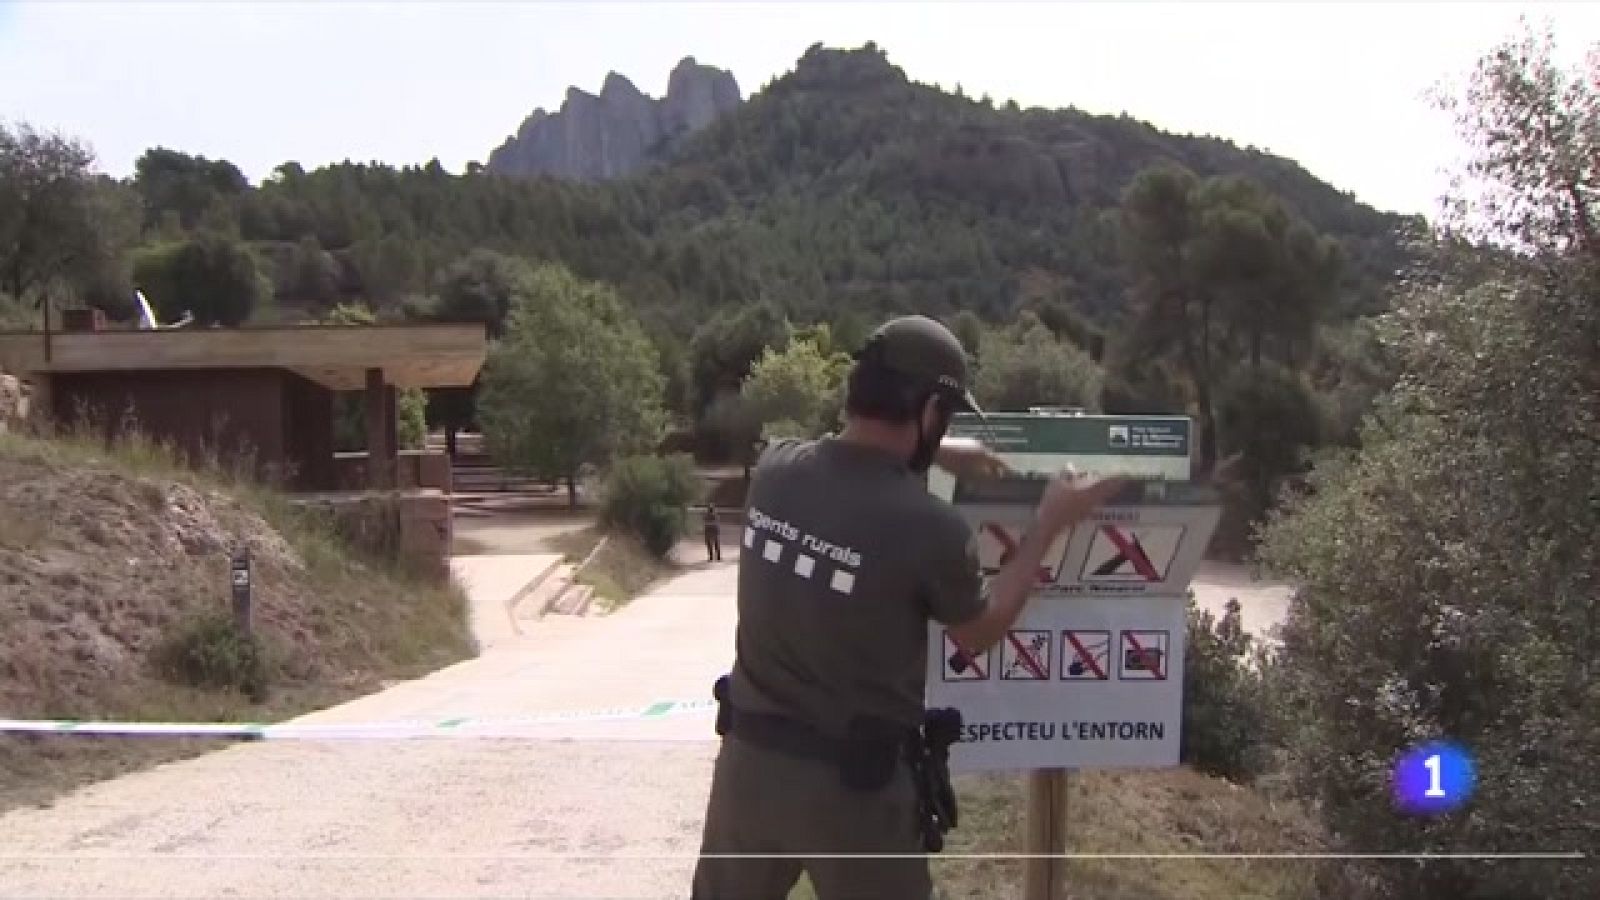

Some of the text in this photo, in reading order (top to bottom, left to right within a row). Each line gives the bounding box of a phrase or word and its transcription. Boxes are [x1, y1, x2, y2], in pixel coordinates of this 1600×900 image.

[802, 534, 861, 567] rurals
[959, 721, 1165, 742] ESPECTEU L'ENTORN
